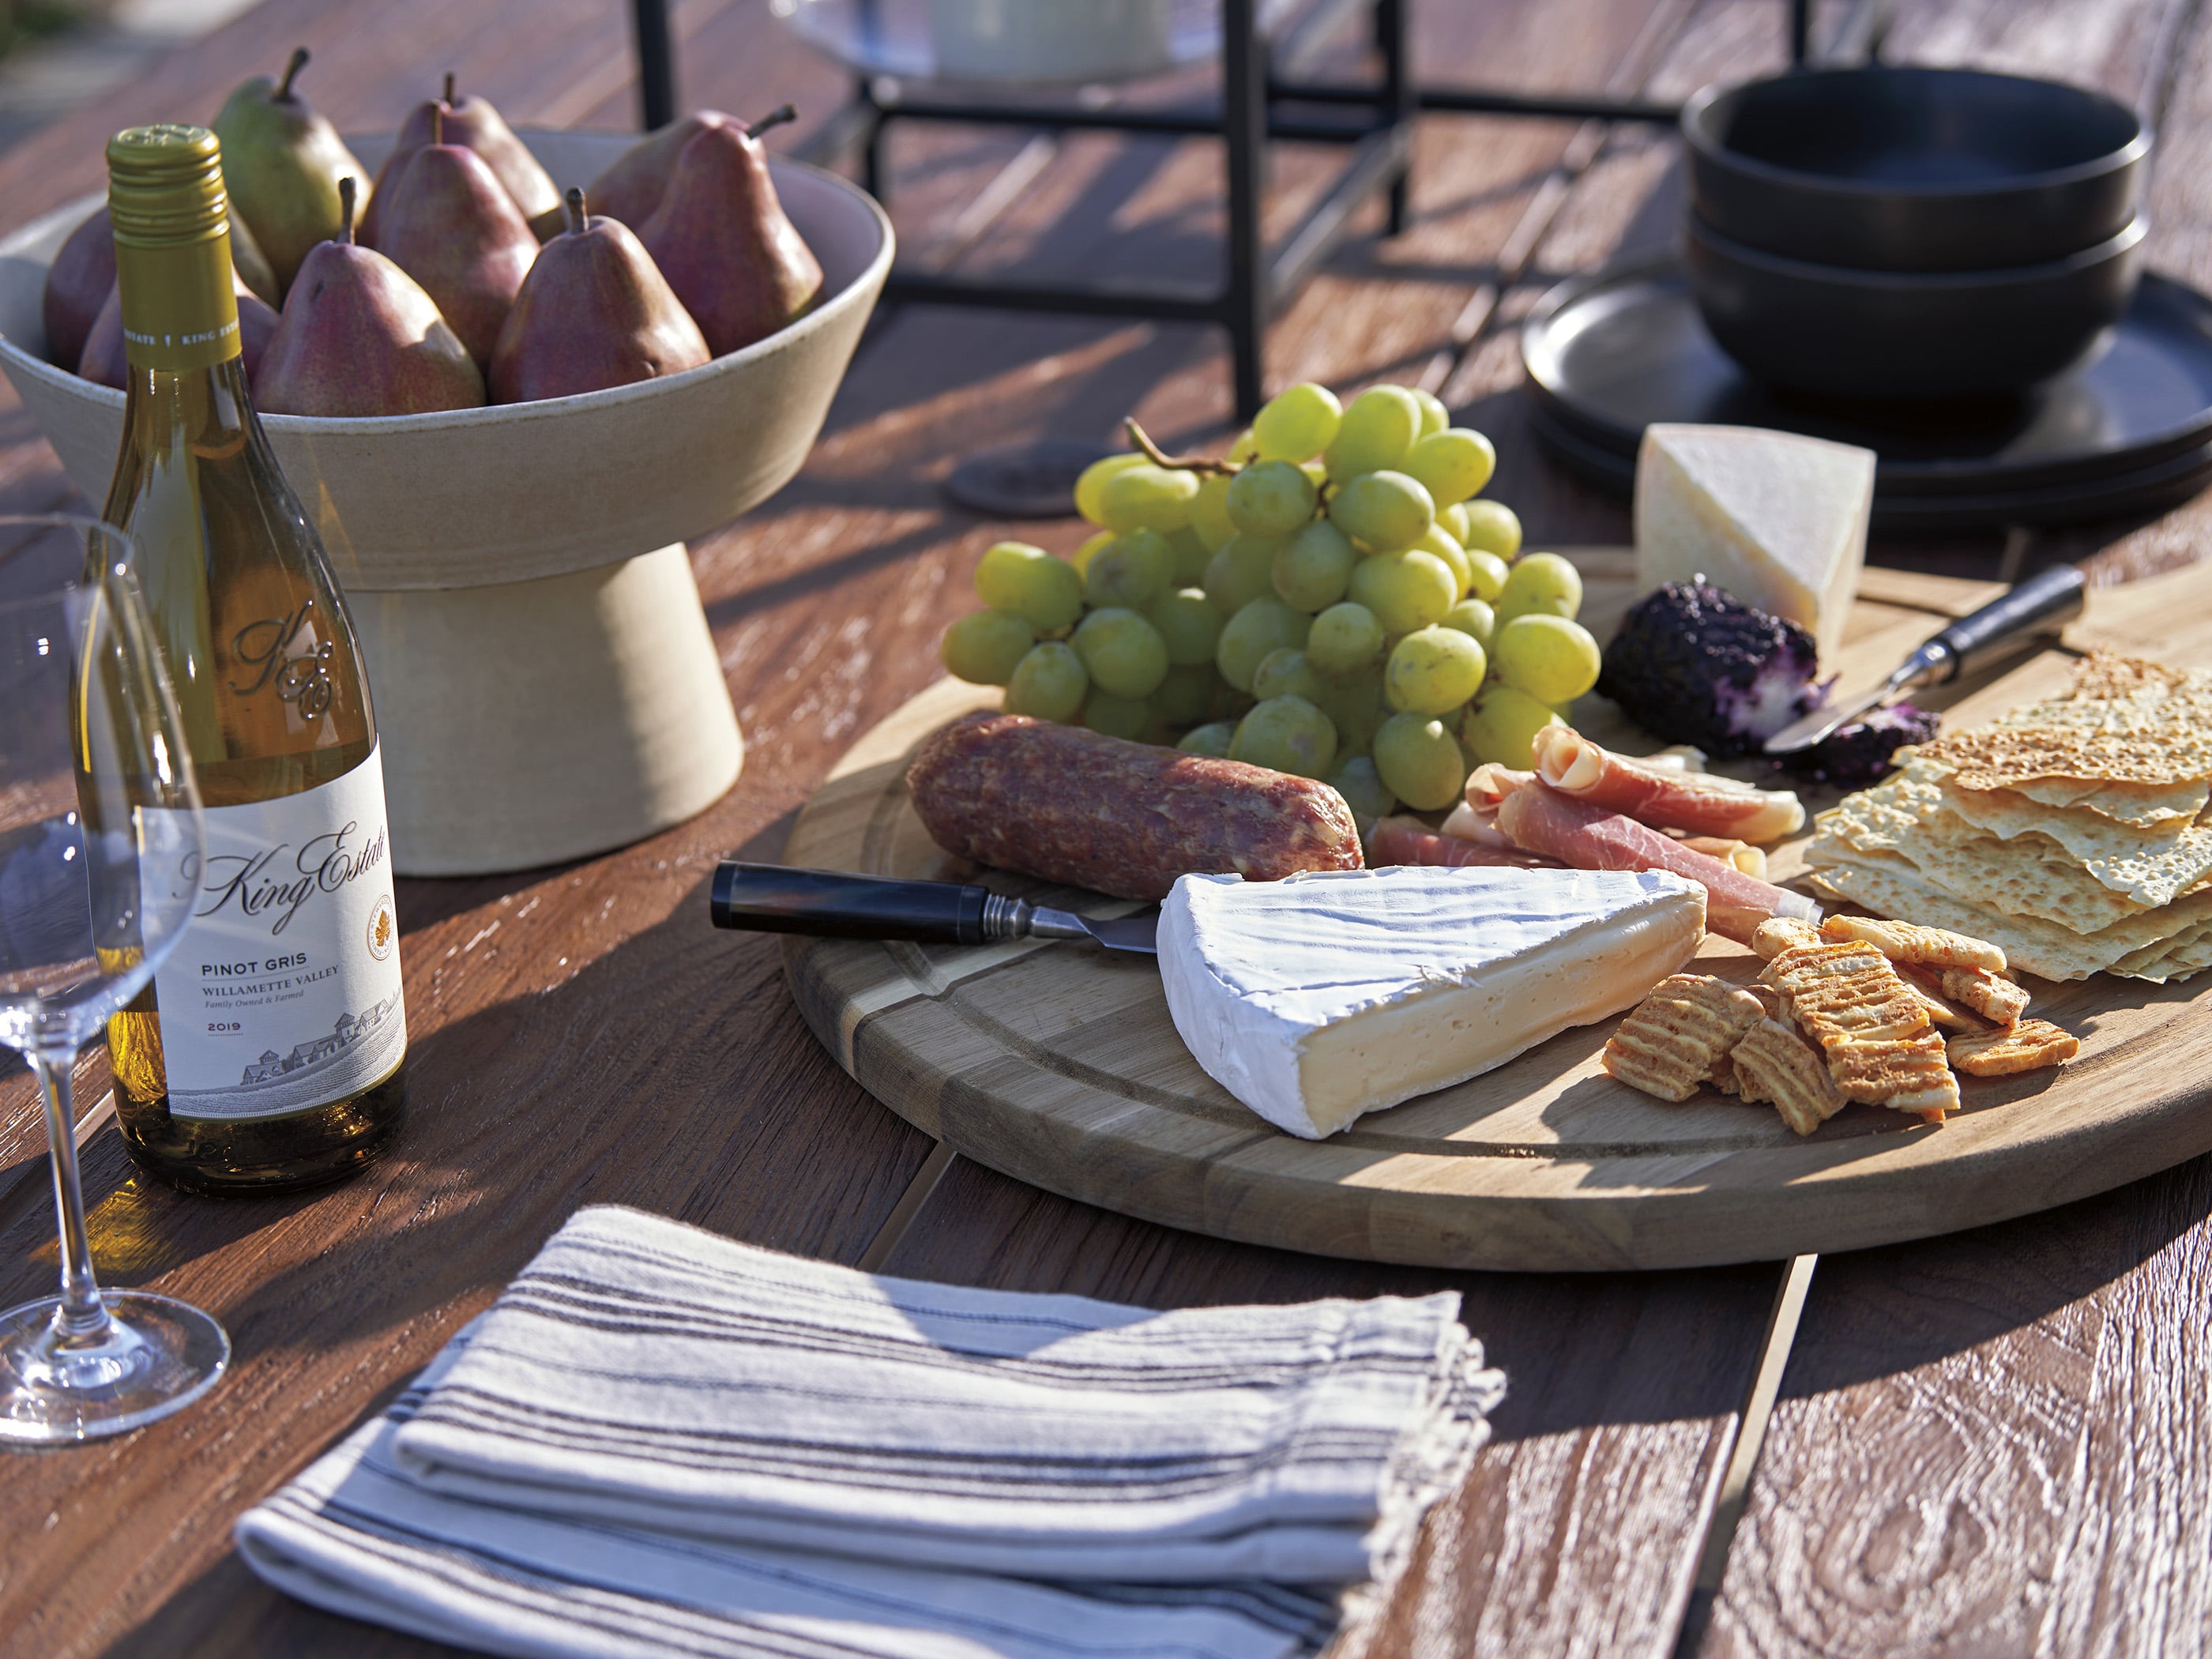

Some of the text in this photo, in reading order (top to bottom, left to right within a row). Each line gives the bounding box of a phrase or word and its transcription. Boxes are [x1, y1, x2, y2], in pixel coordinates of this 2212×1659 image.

[181, 330, 215, 345] KING
[171, 844, 315, 935] King
[201, 952, 307, 976] PINOT GRIS
[202, 965, 340, 997] WILLAMETTE VALLEY
[205, 1001, 233, 1010] Family
[235, 996, 263, 1007] Owned
[275, 989, 304, 1003] Farmed
[208, 1022, 241, 1032] 2019
